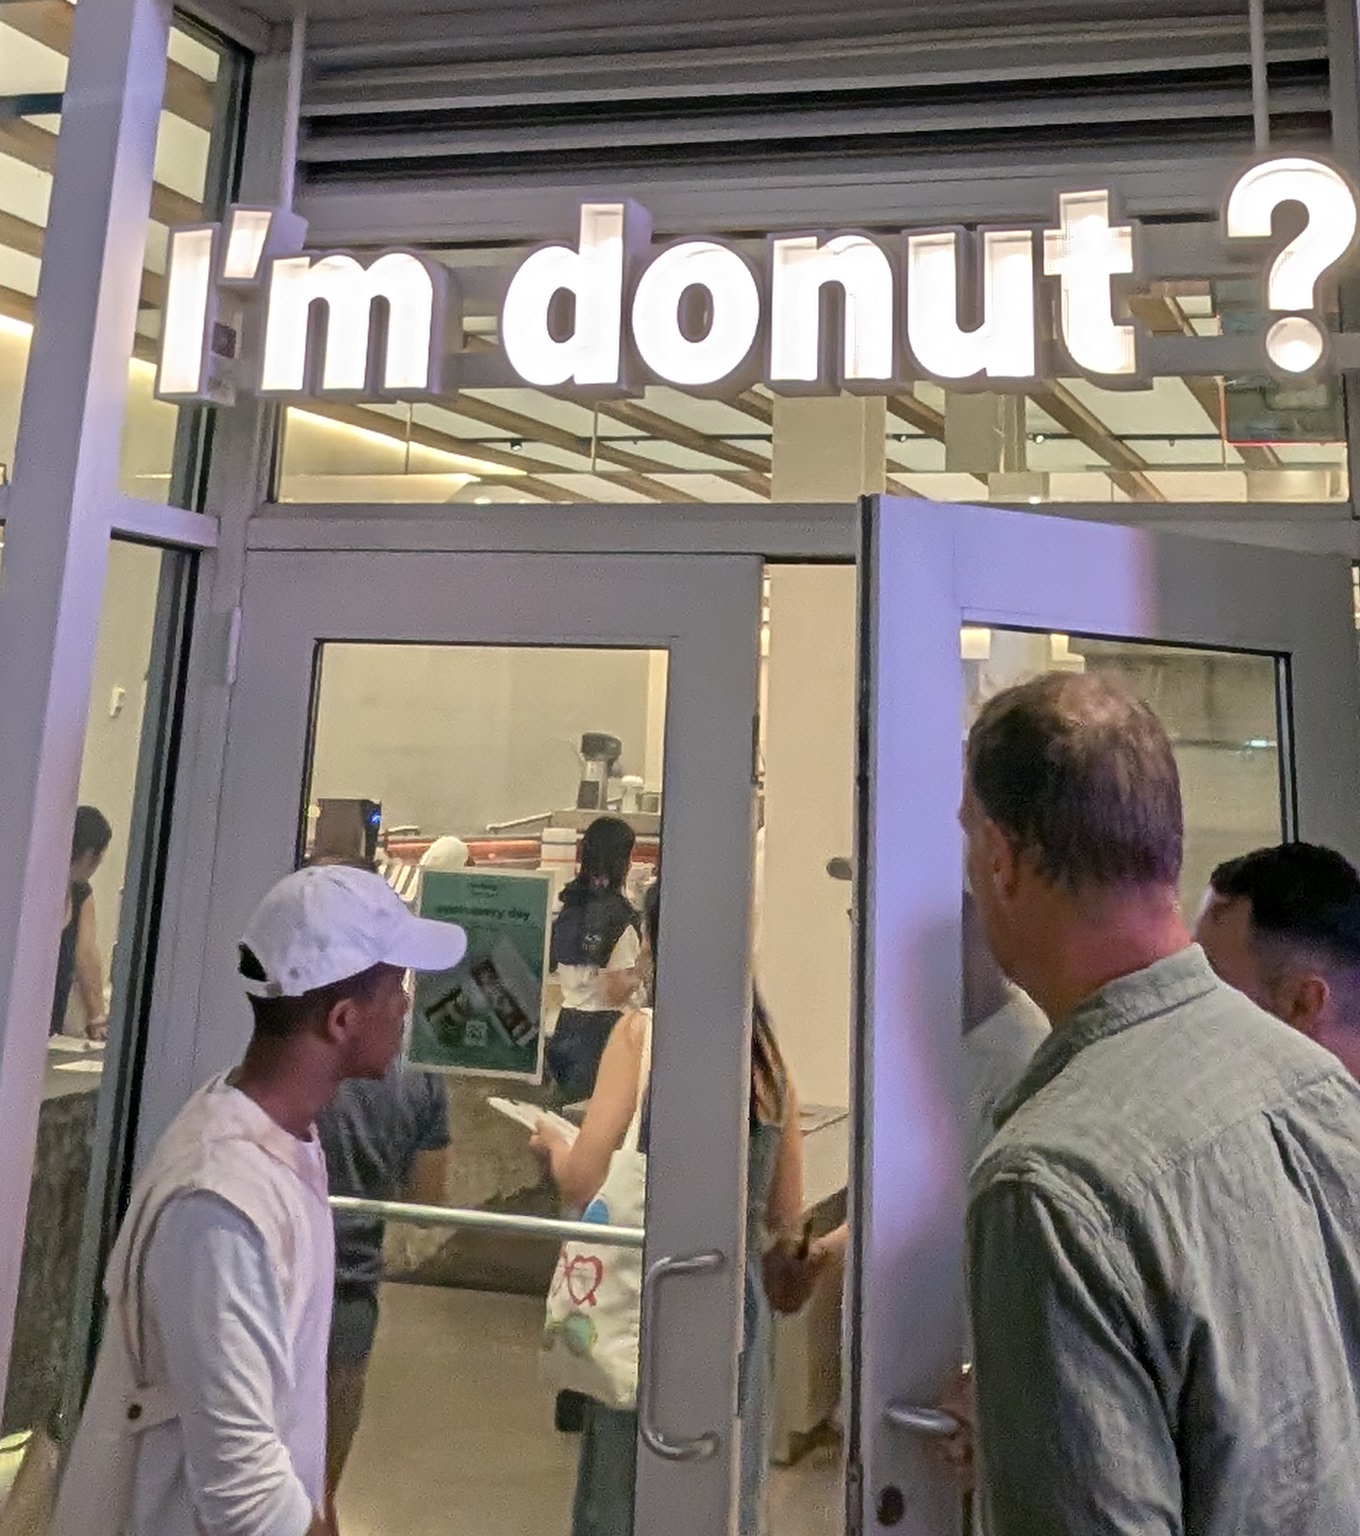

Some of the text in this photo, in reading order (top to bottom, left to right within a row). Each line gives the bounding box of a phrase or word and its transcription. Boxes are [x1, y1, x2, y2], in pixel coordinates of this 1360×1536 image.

[156, 157, 1359, 395] I'm donut ?
